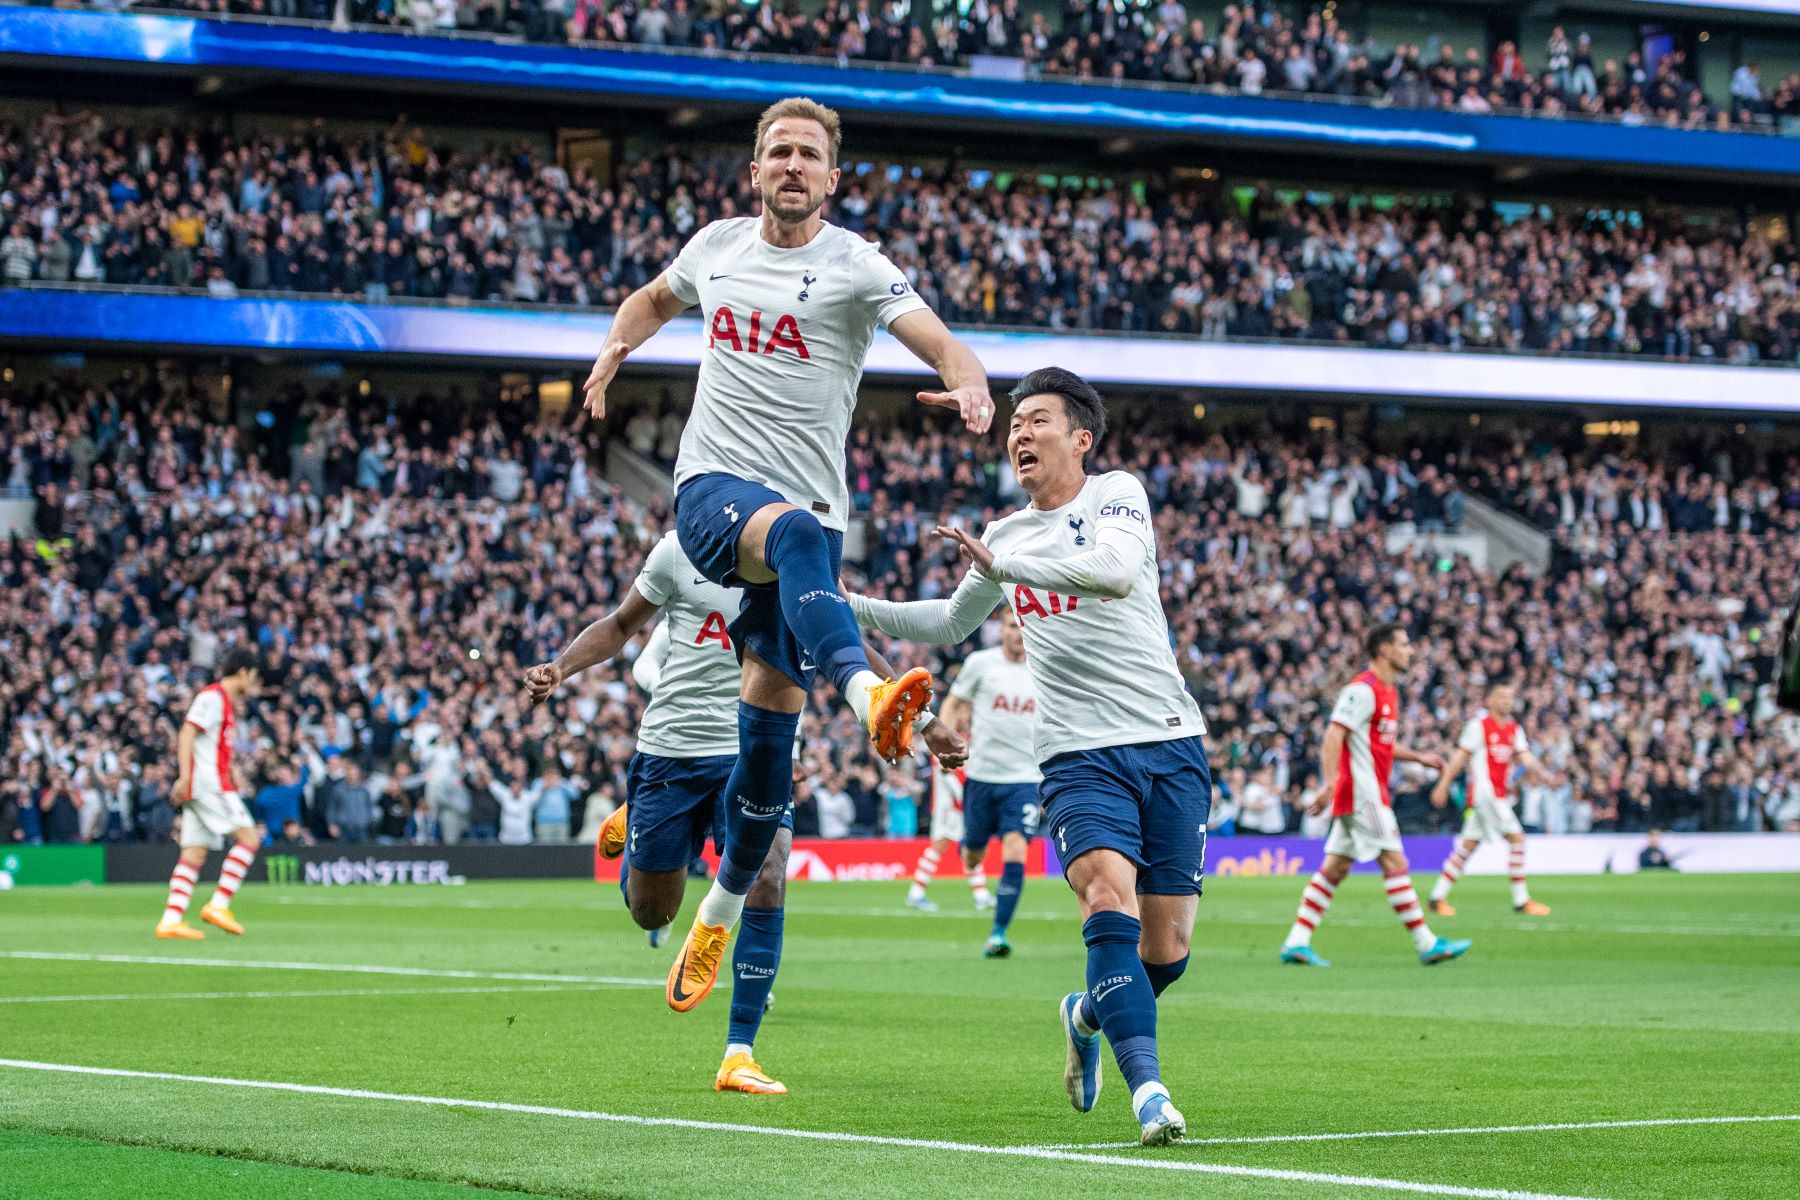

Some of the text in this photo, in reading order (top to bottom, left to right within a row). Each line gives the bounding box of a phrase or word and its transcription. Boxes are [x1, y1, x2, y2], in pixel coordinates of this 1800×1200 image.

[709, 306, 811, 359] AIA
[1100, 503, 1148, 531] cinch
[992, 694, 1036, 714] AIA
[304, 856, 450, 887] MONSTER
[736, 962, 775, 975] SPURS
[1091, 975, 1133, 997] SPURS
